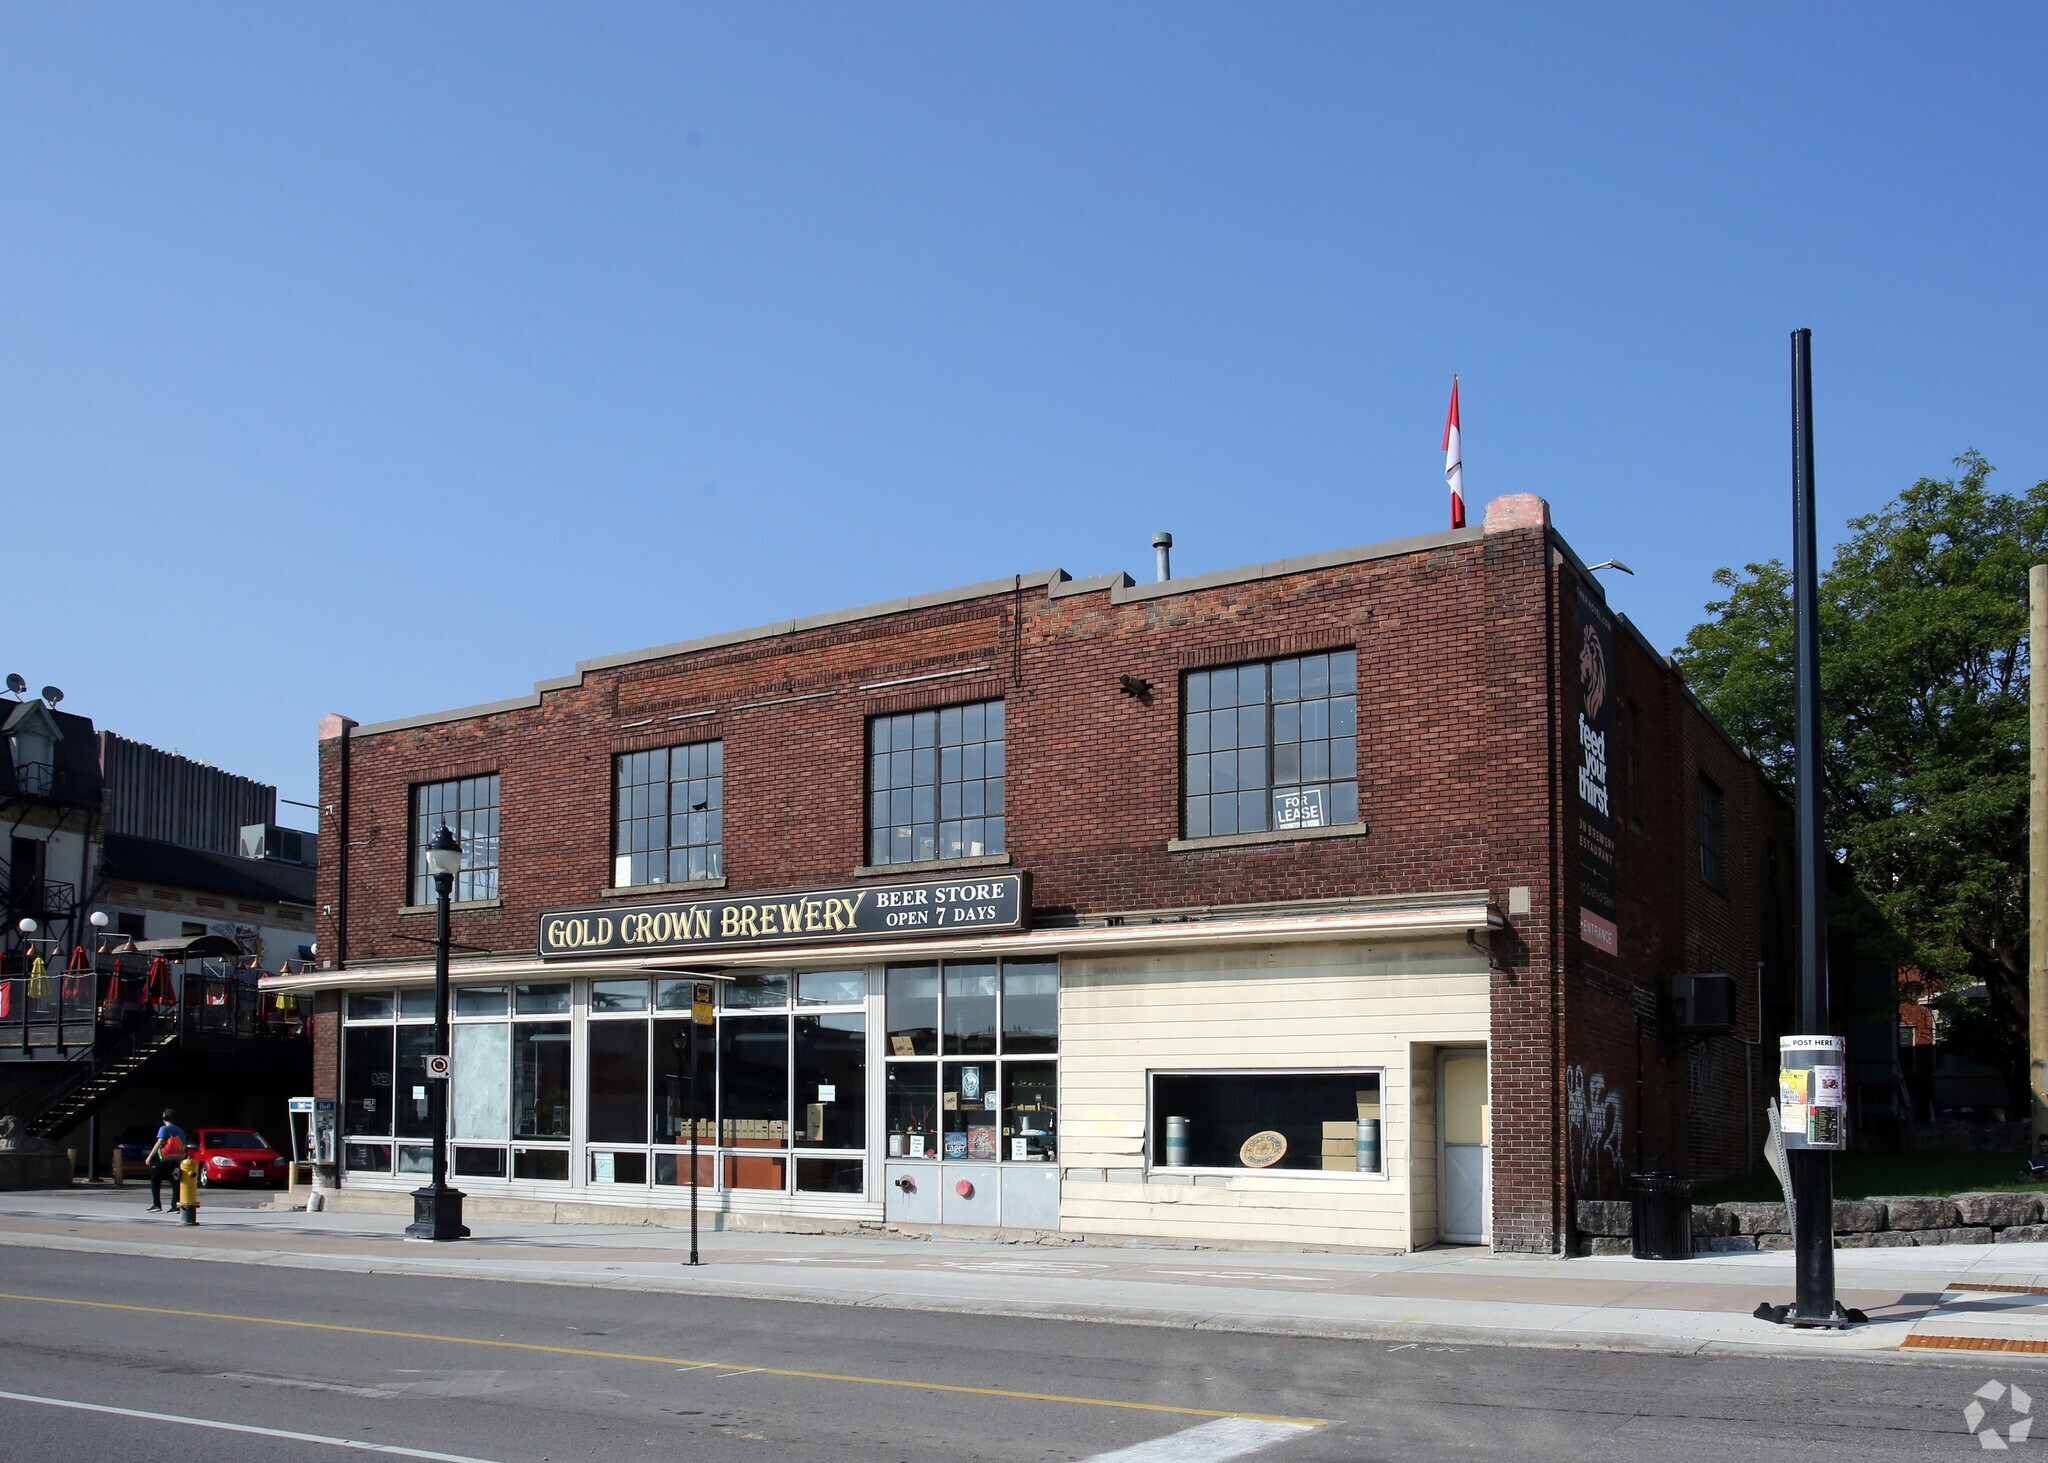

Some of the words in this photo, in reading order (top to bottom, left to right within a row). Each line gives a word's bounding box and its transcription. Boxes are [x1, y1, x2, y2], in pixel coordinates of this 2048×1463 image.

[1578, 712, 1606, 764] feed
[1584, 748, 1606, 784] your
[1285, 796, 1308, 808] FOR
[1578, 764, 1609, 818] thirst
[1277, 805, 1319, 822] LEASE
[1588, 824, 1615, 852] BREWERY
[876, 889, 928, 908] BEER
[935, 883, 1004, 903] STORE
[548, 917, 613, 949] GOLD
[620, 904, 712, 944] CROWN
[720, 890, 867, 938] BREWERY
[886, 911, 928, 926] OPEN
[936, 907, 946, 925] 7
[954, 906, 996, 922] DAYS
[1583, 922, 1612, 944] ENTRANCE
[1792, 1039, 1812, 1047] POST
[1814, 1039, 1833, 1047] HERE
[945, 1143, 966, 1154] Lager
